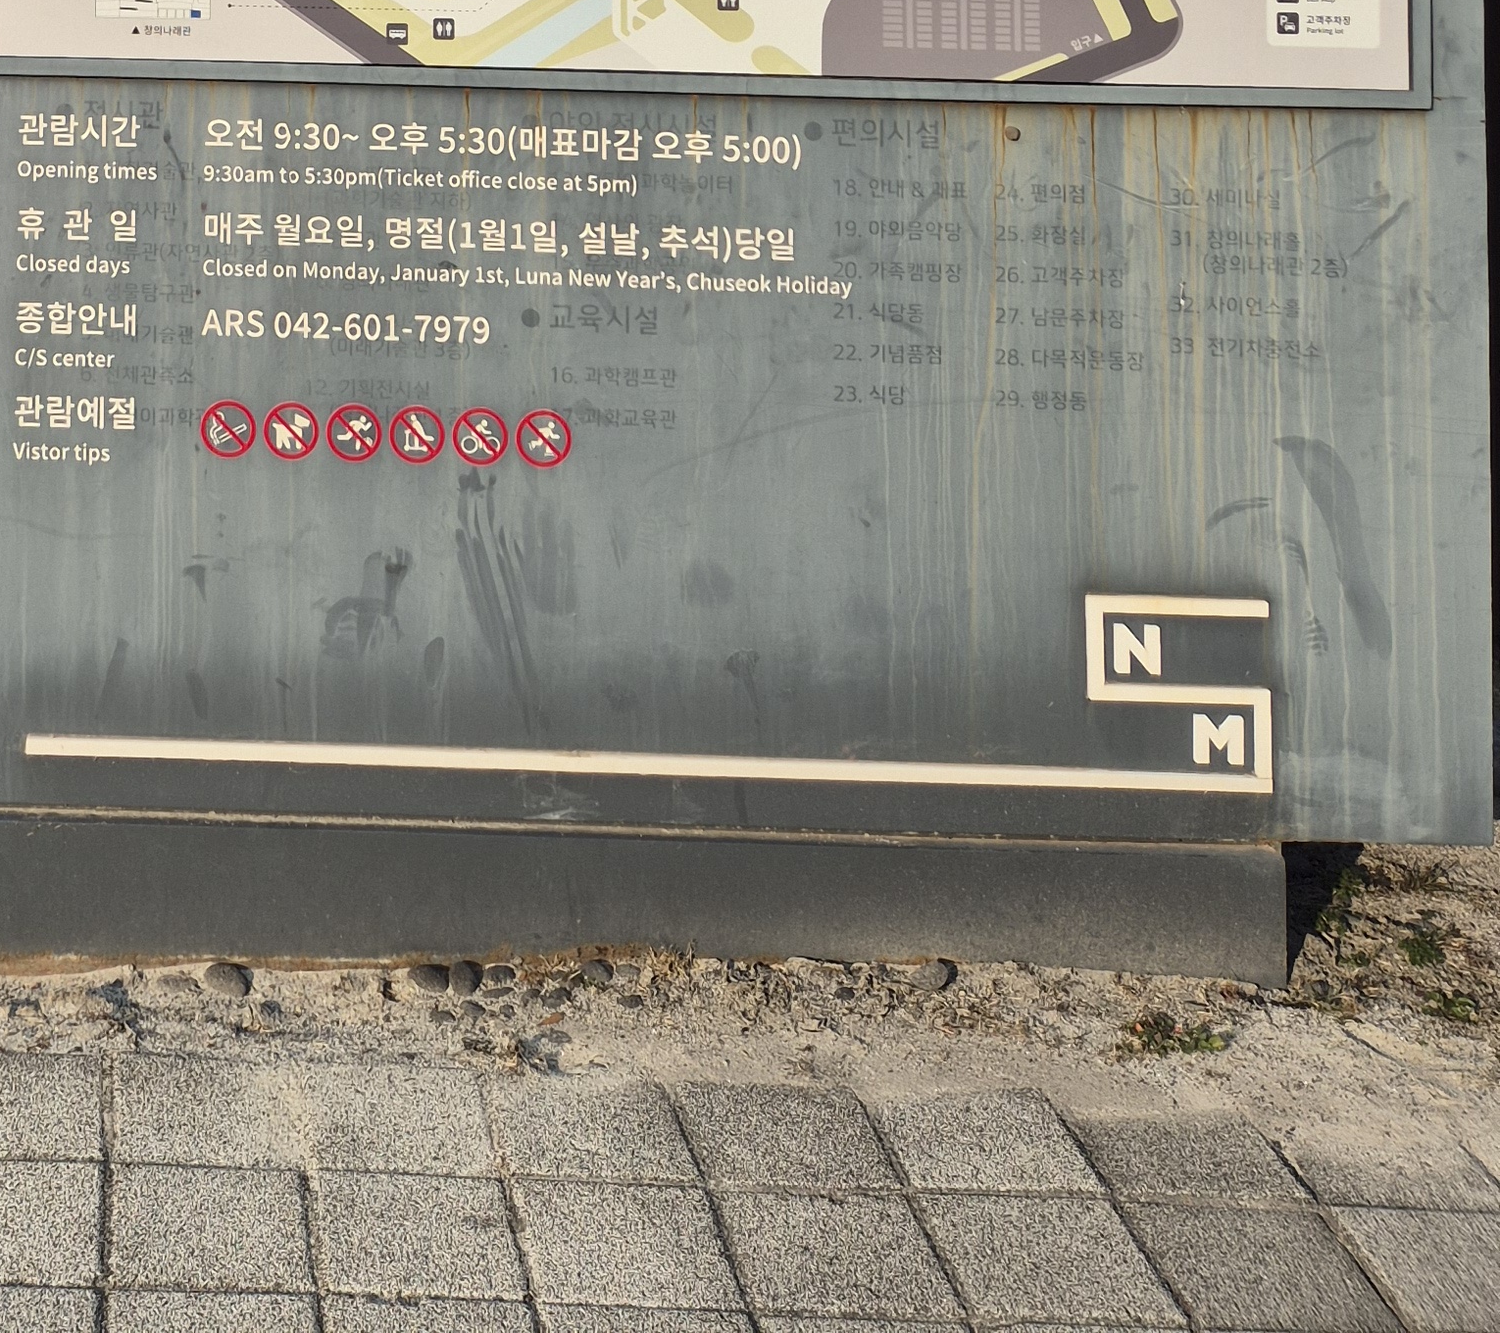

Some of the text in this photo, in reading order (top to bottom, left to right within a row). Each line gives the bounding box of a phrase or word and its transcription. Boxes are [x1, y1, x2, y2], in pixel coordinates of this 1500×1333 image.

[144, 25, 191, 37] 창의나래관
[1071, 35, 1092, 52] 입구
[17, 113, 141, 149] 관람시간
[205, 117, 264, 150] 오전
[274, 121, 360, 153] 9:30~
[369, 121, 430, 156] 오후
[438, 124, 641, 162] 5:30(매표마감
[652, 130, 714, 164] 오후
[722, 134, 802, 171] 5:00)
[831, 117, 940, 149] 편의시설
[17, 160, 99, 184] Opening
[103, 161, 158, 181] times
[203, 165, 274, 185] 9:30am
[279, 167, 299, 184] to
[304, 167, 444, 190] 5:30pm(Ticket
[448, 171, 502, 189] office
[507, 172, 558, 191] close
[562, 175, 583, 192] at
[587, 174, 638, 196] 5pm)
[17, 208, 46, 242] 휴
[63, 208, 93, 242] 관
[110, 209, 138, 243] 일
[204, 213, 264, 245] 매주
[274, 214, 375, 253] 월요일,
[385, 216, 570, 257] 명절(1월1일,
[578, 221, 650, 260] 설날,
[659, 224, 796, 263] 추석)당일
[15, 254, 131, 278] Closed days
[202, 259, 269, 279] Closed
[273, 263, 297, 279] on
[302, 261, 386, 285] Monday,
[391, 264, 470, 286] January
[475, 267, 511, 288] 1st,
[515, 267, 564, 288] Luna
[568, 268, 613, 288] New
[686, 273, 772, 295] Chuseok
[776, 275, 853, 299] Holiday
[15, 301, 138, 337] 종합안내
[202, 308, 265, 338] ARS
[274, 310, 491, 345] 042-601-7979
[549, 302, 659, 337] 교육시설
[14, 348, 115, 368] C/S center
[13, 395, 137, 431] 관람예절
[13, 442, 111, 463] Vistor tips
[1113, 622, 1161, 676] N
[1192, 713, 1245, 766] M
